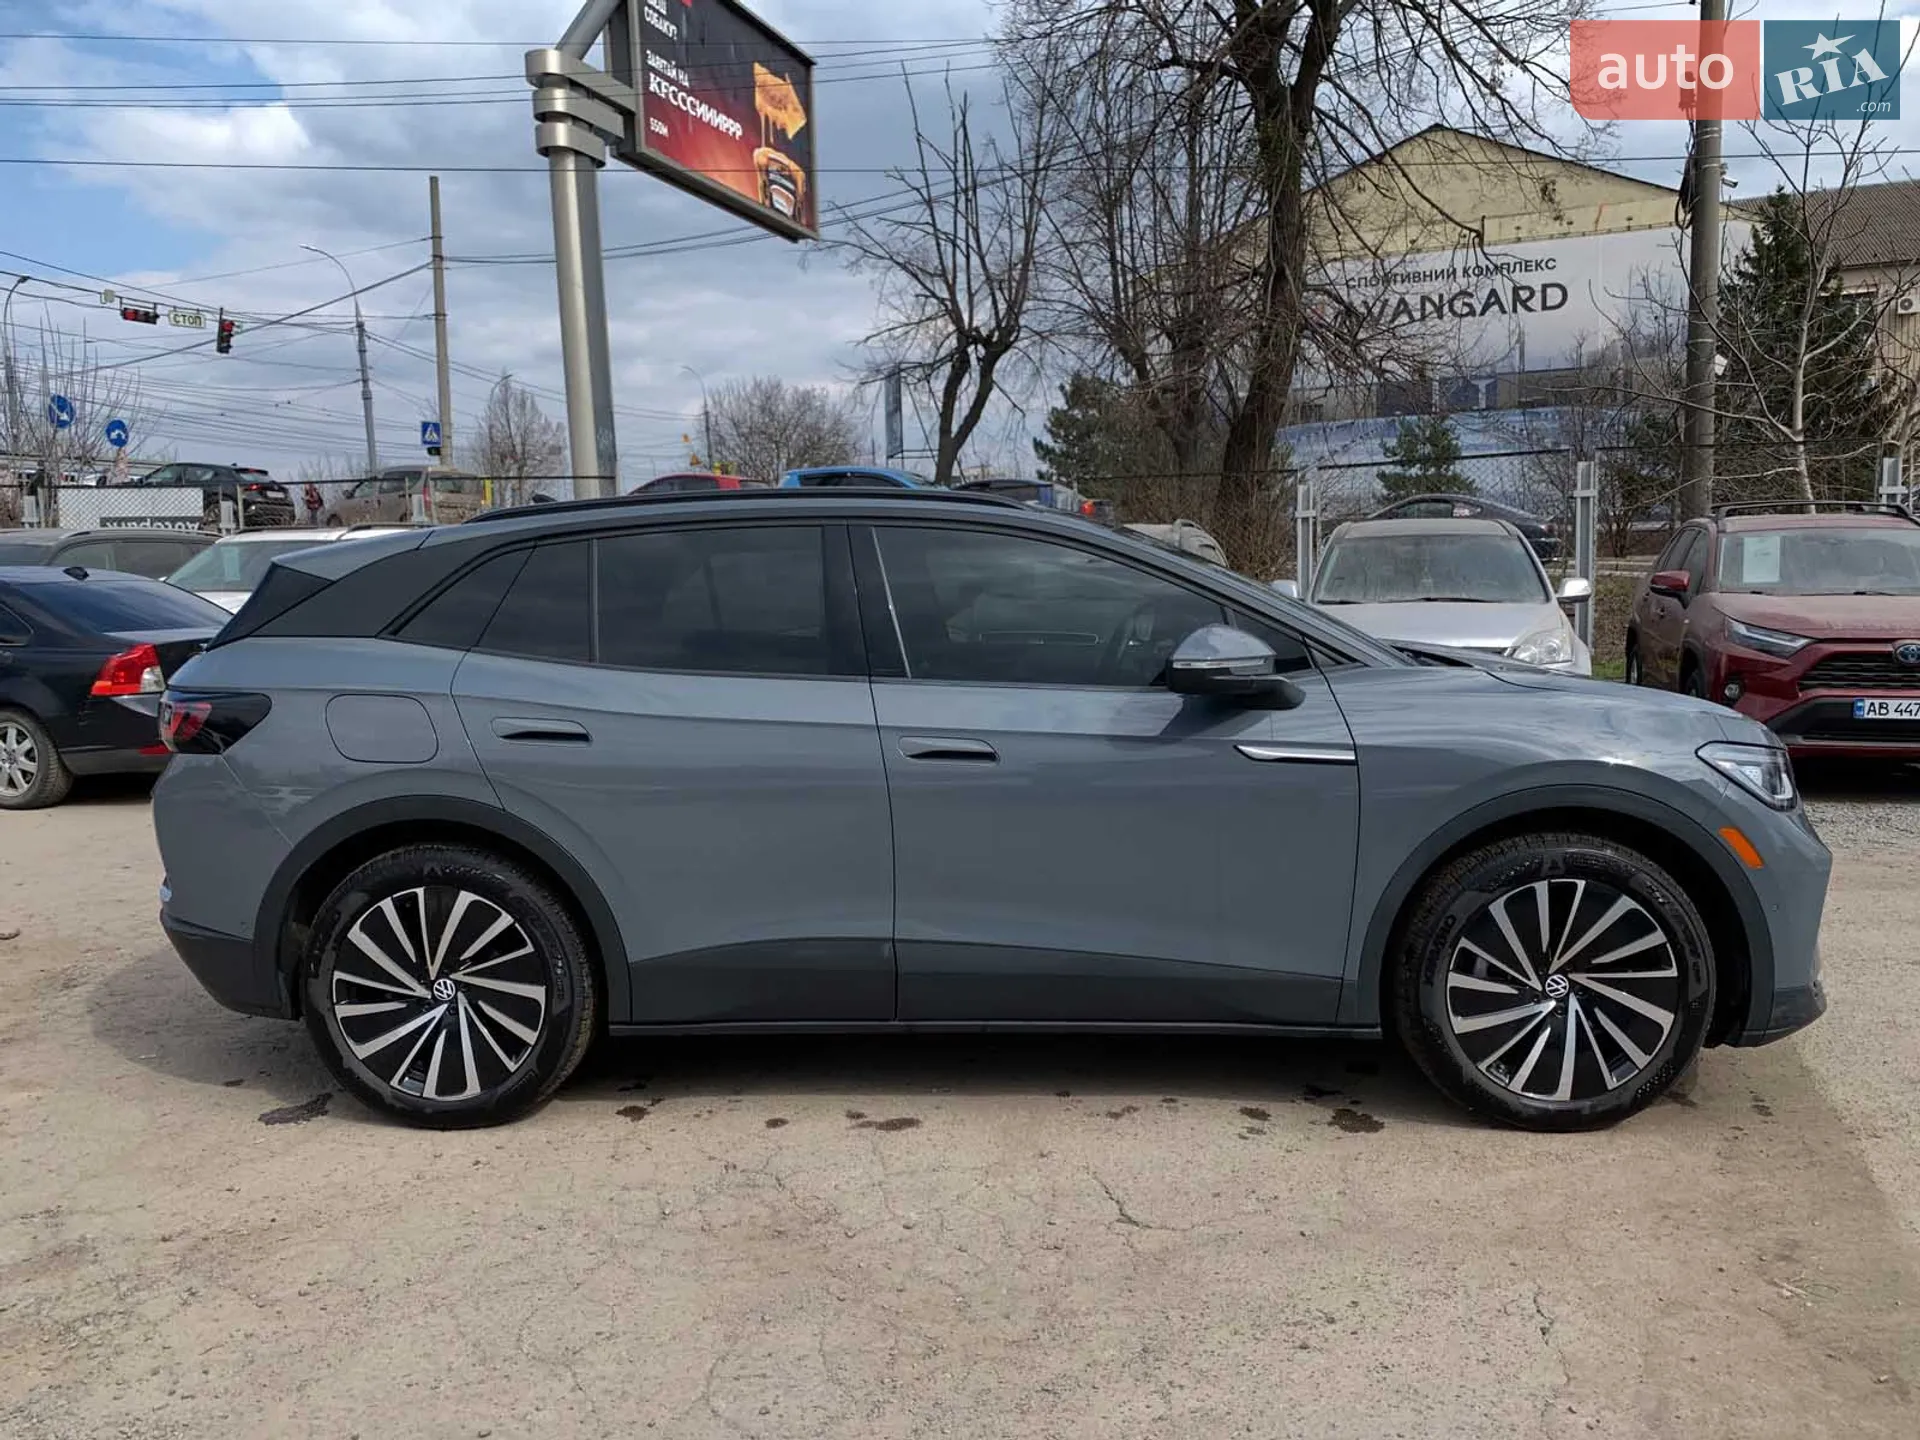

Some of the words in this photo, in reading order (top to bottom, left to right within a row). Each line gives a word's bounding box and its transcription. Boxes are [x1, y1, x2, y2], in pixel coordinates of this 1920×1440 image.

[1346, 266, 1457, 289] СПОТИВНИЙ
[1462, 258, 1557, 279] КОМПЛЕКС
[173, 314, 202, 326] СТОП
[1866, 702, 1889, 716] AB
